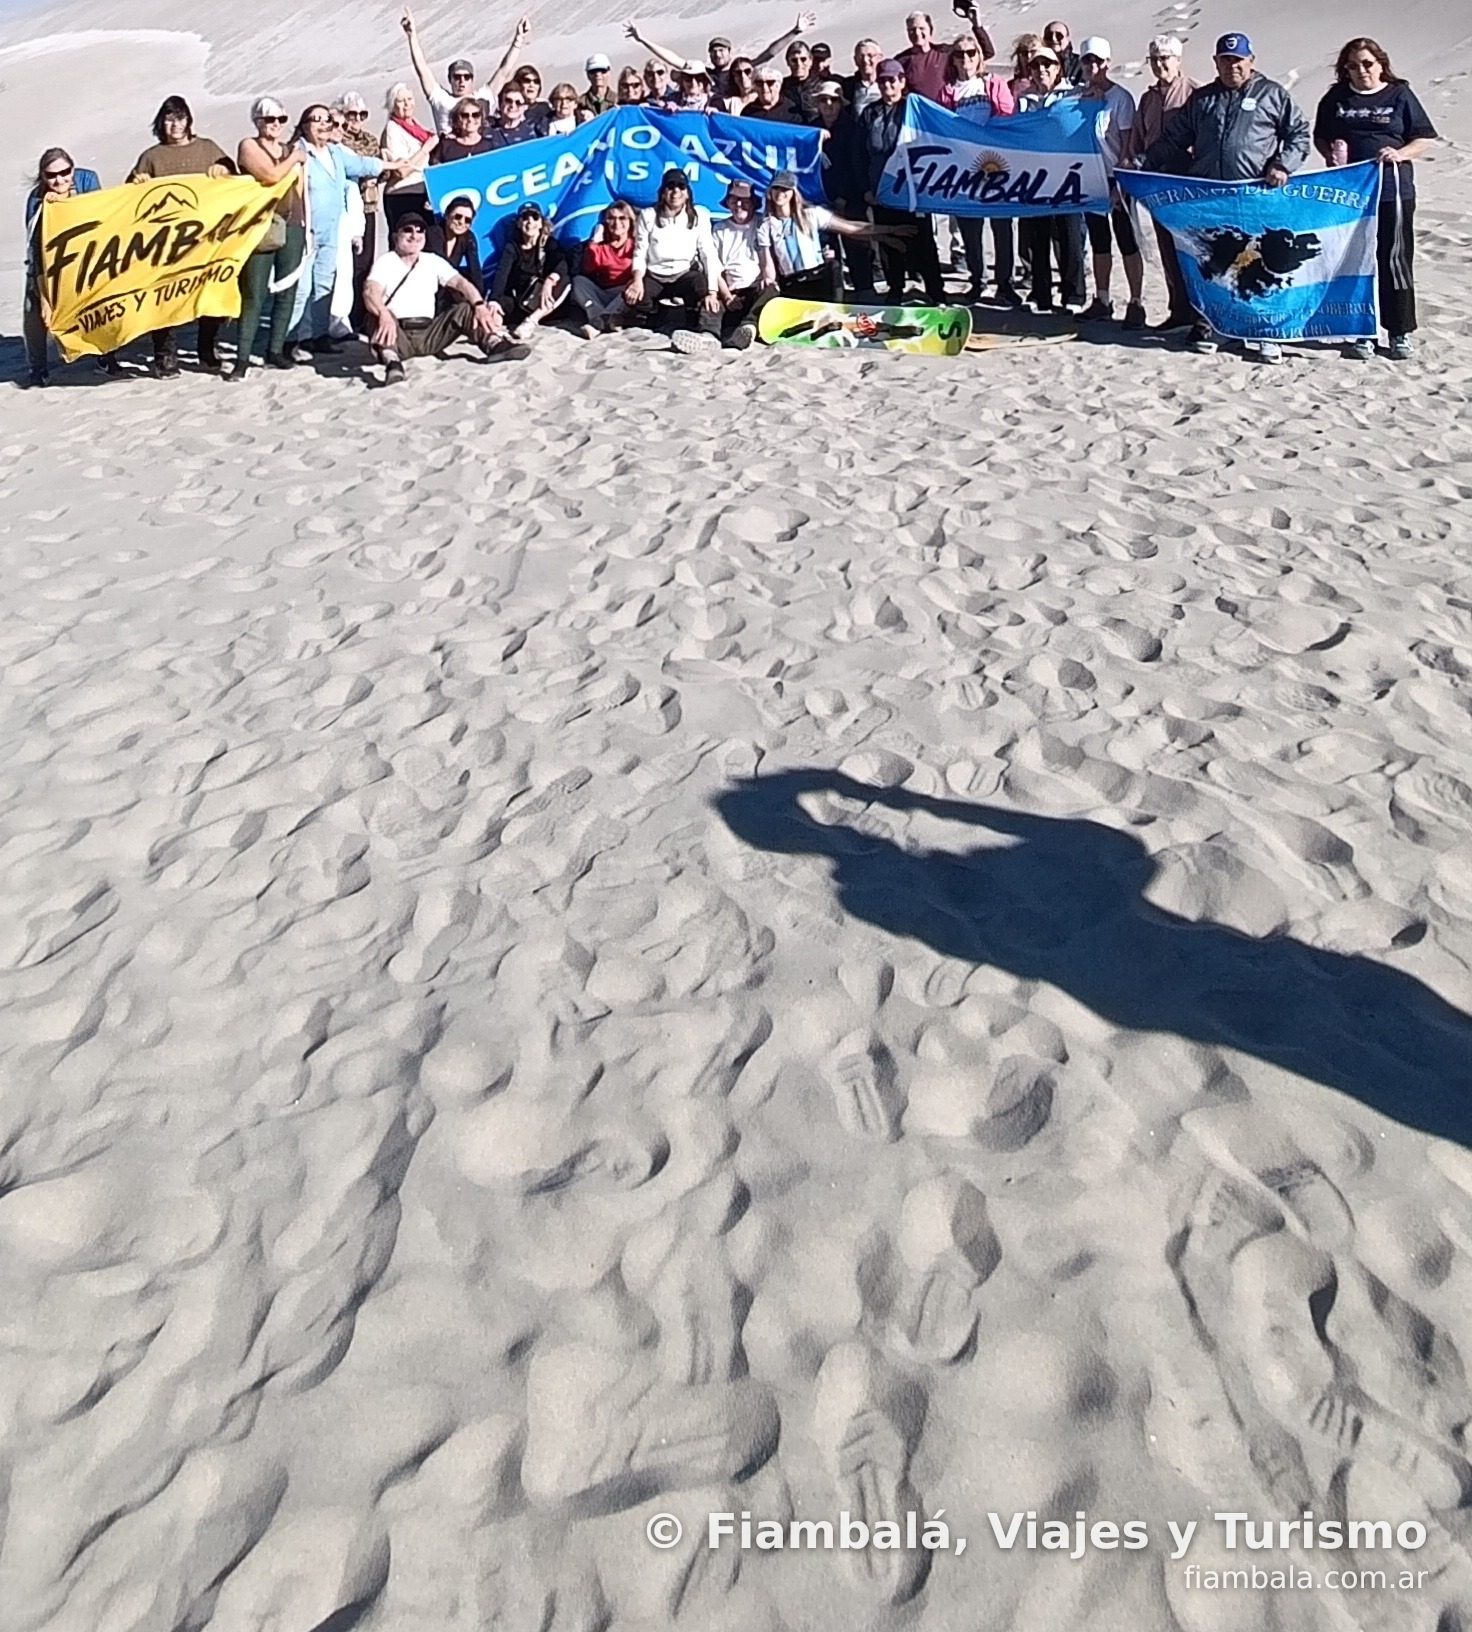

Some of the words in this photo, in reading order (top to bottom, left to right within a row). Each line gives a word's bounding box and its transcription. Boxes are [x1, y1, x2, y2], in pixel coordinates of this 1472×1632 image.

[892, 145, 1089, 206] FIAMBALÁ
[1282, 184, 1370, 209] GUERRA
[78, 299, 125, 334] VIAJES
[134, 291, 147, 312] Y
[153, 265, 235, 306] TURISMO
